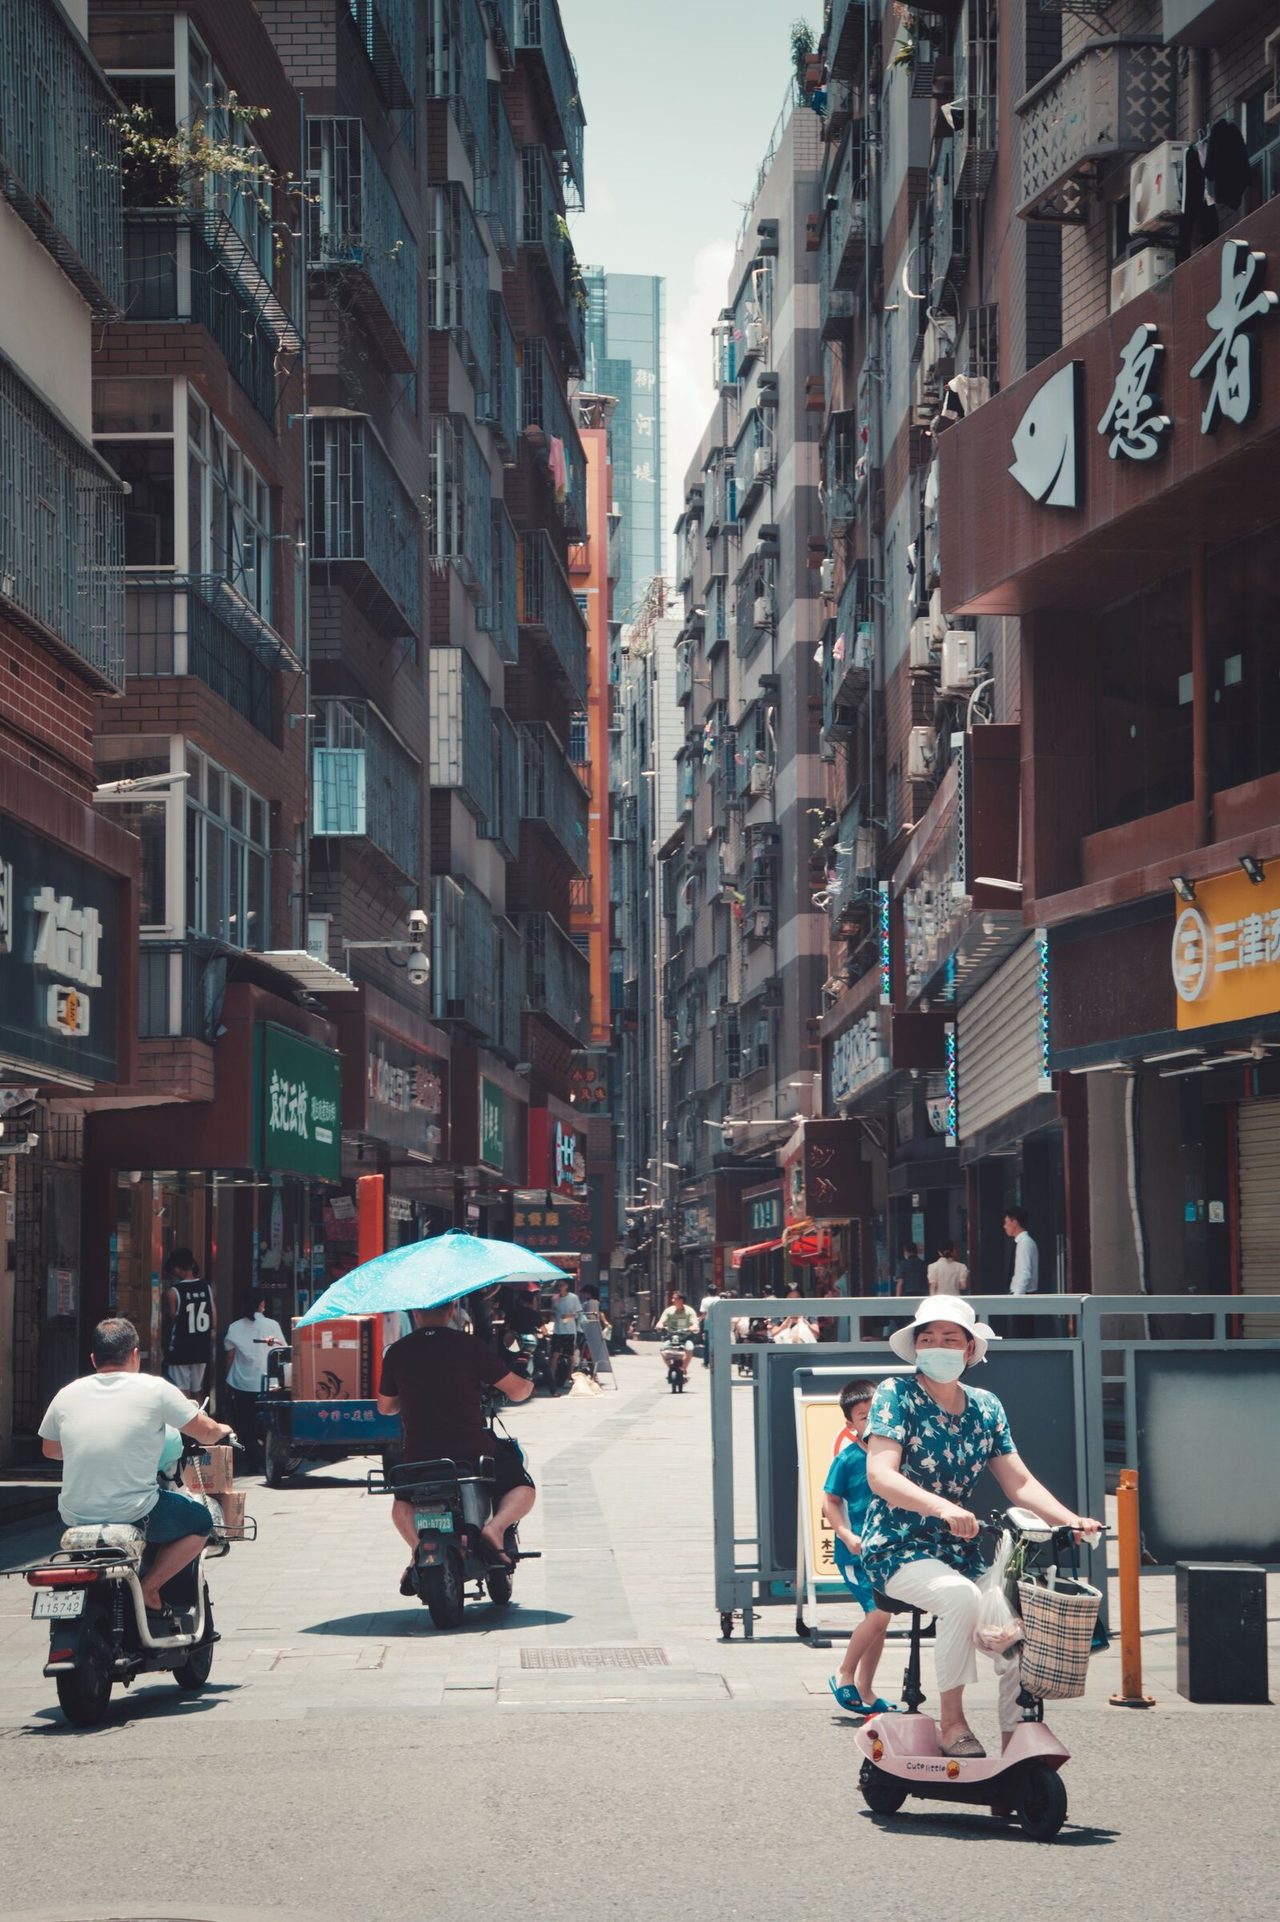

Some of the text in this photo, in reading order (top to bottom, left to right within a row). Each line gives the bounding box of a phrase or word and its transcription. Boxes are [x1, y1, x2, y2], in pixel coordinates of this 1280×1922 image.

[185, 1301, 210, 1334] 16
[39, 1602, 80, 1614] 115742
[906, 1762, 946, 1773] Cute little
